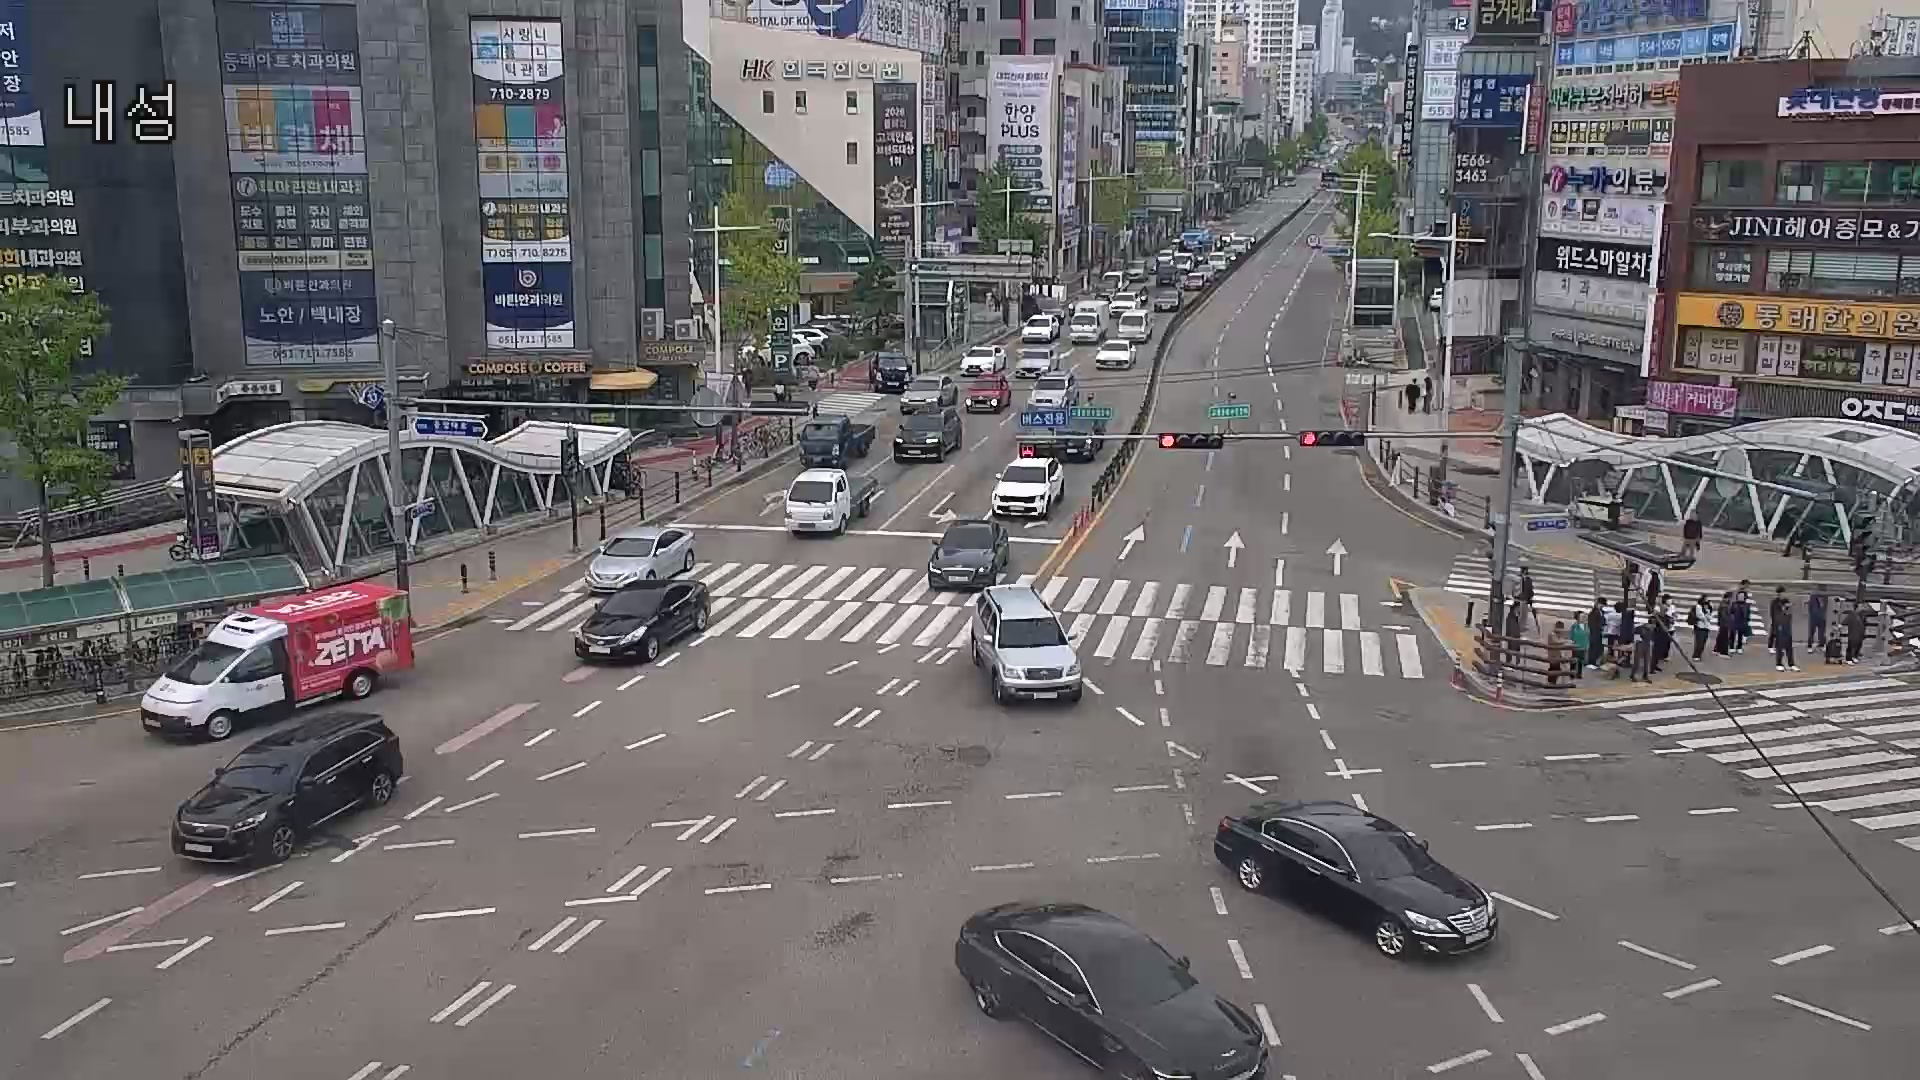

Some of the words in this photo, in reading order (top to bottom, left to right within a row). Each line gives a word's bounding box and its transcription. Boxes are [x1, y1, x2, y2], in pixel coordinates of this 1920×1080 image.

[504, 27, 546, 41] 사랑니
[741, 60, 776, 80] HK
[783, 60, 902, 80] 한국한의원
[490, 88, 549, 100] 710-2879
[1004, 102, 1036, 123] 한양
[1001, 124, 1040, 138] PLUS
[1457, 153, 1490, 167] 1566-
[1456, 170, 1487, 182] 3463
[260, 308, 294, 324] 노안
[311, 306, 361, 324] 백내장
[1756, 304, 1920, 337] 동래한의원
[468, 363, 527, 374] COMPOSE
[544, 362, 586, 373] COFFEE
[1022, 412, 1064, 425] 버스전용
[315, 627, 385, 666] ZETTA
